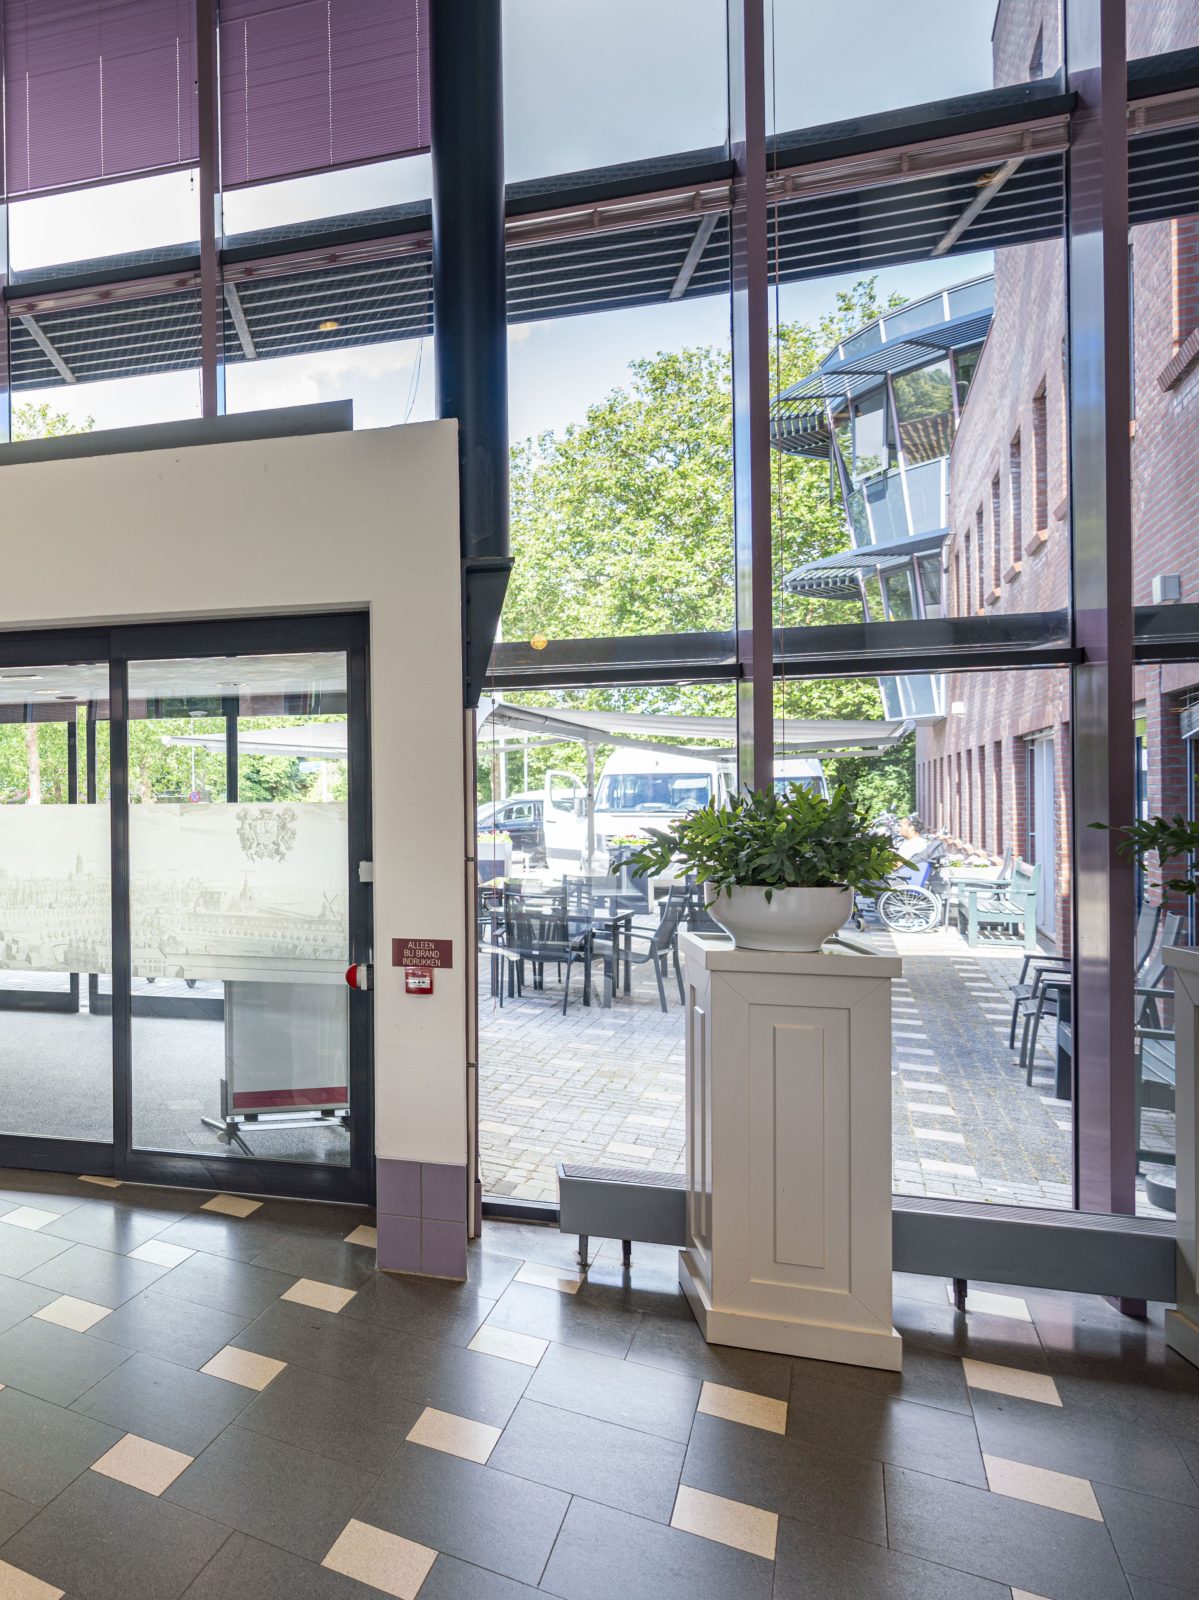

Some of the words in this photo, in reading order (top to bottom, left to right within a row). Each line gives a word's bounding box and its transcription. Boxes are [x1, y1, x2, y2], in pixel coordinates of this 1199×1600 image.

[408, 941, 435, 949] ALLEEN
[403, 949, 415, 957] BIJ
[415, 950, 440, 958] BRAND
[402, 957, 441, 967] INDRUKKEN
